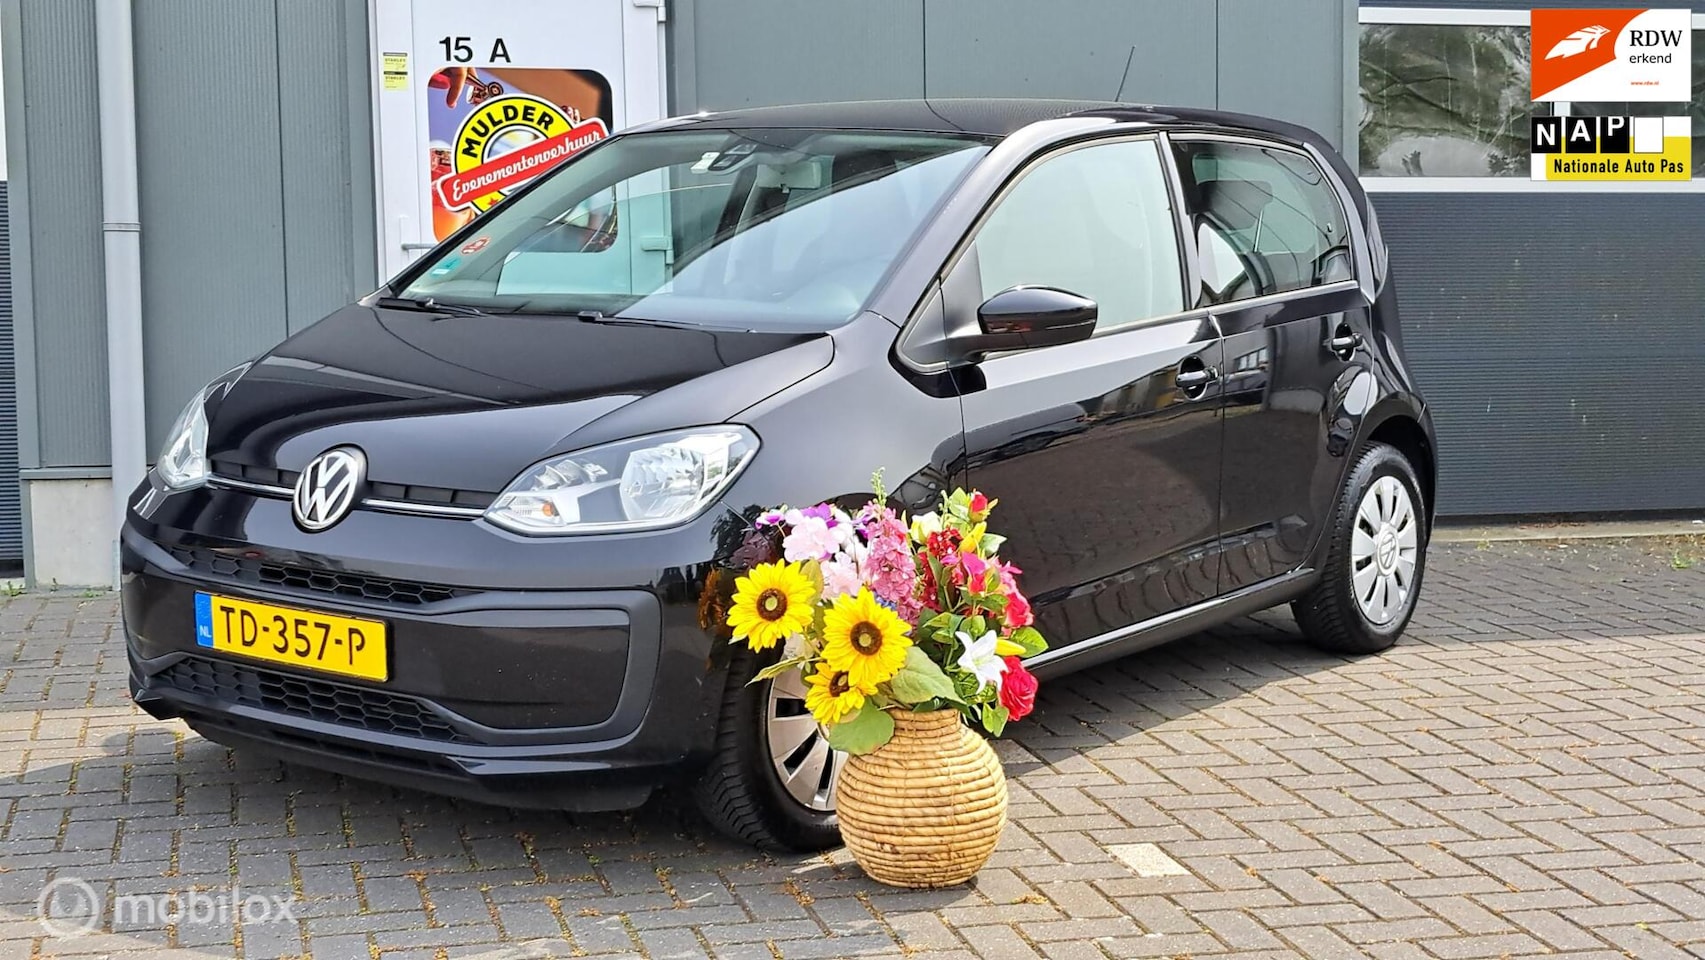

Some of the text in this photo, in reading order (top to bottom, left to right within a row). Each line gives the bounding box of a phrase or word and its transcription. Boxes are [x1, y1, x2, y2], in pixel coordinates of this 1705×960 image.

[438, 36, 512, 63] 15 A
[461, 104, 555, 158] MULDER
[452, 129, 601, 201] Evenementenverhuur
[199, 625, 212, 638] NL
[219, 604, 366, 665] TD-357-P
